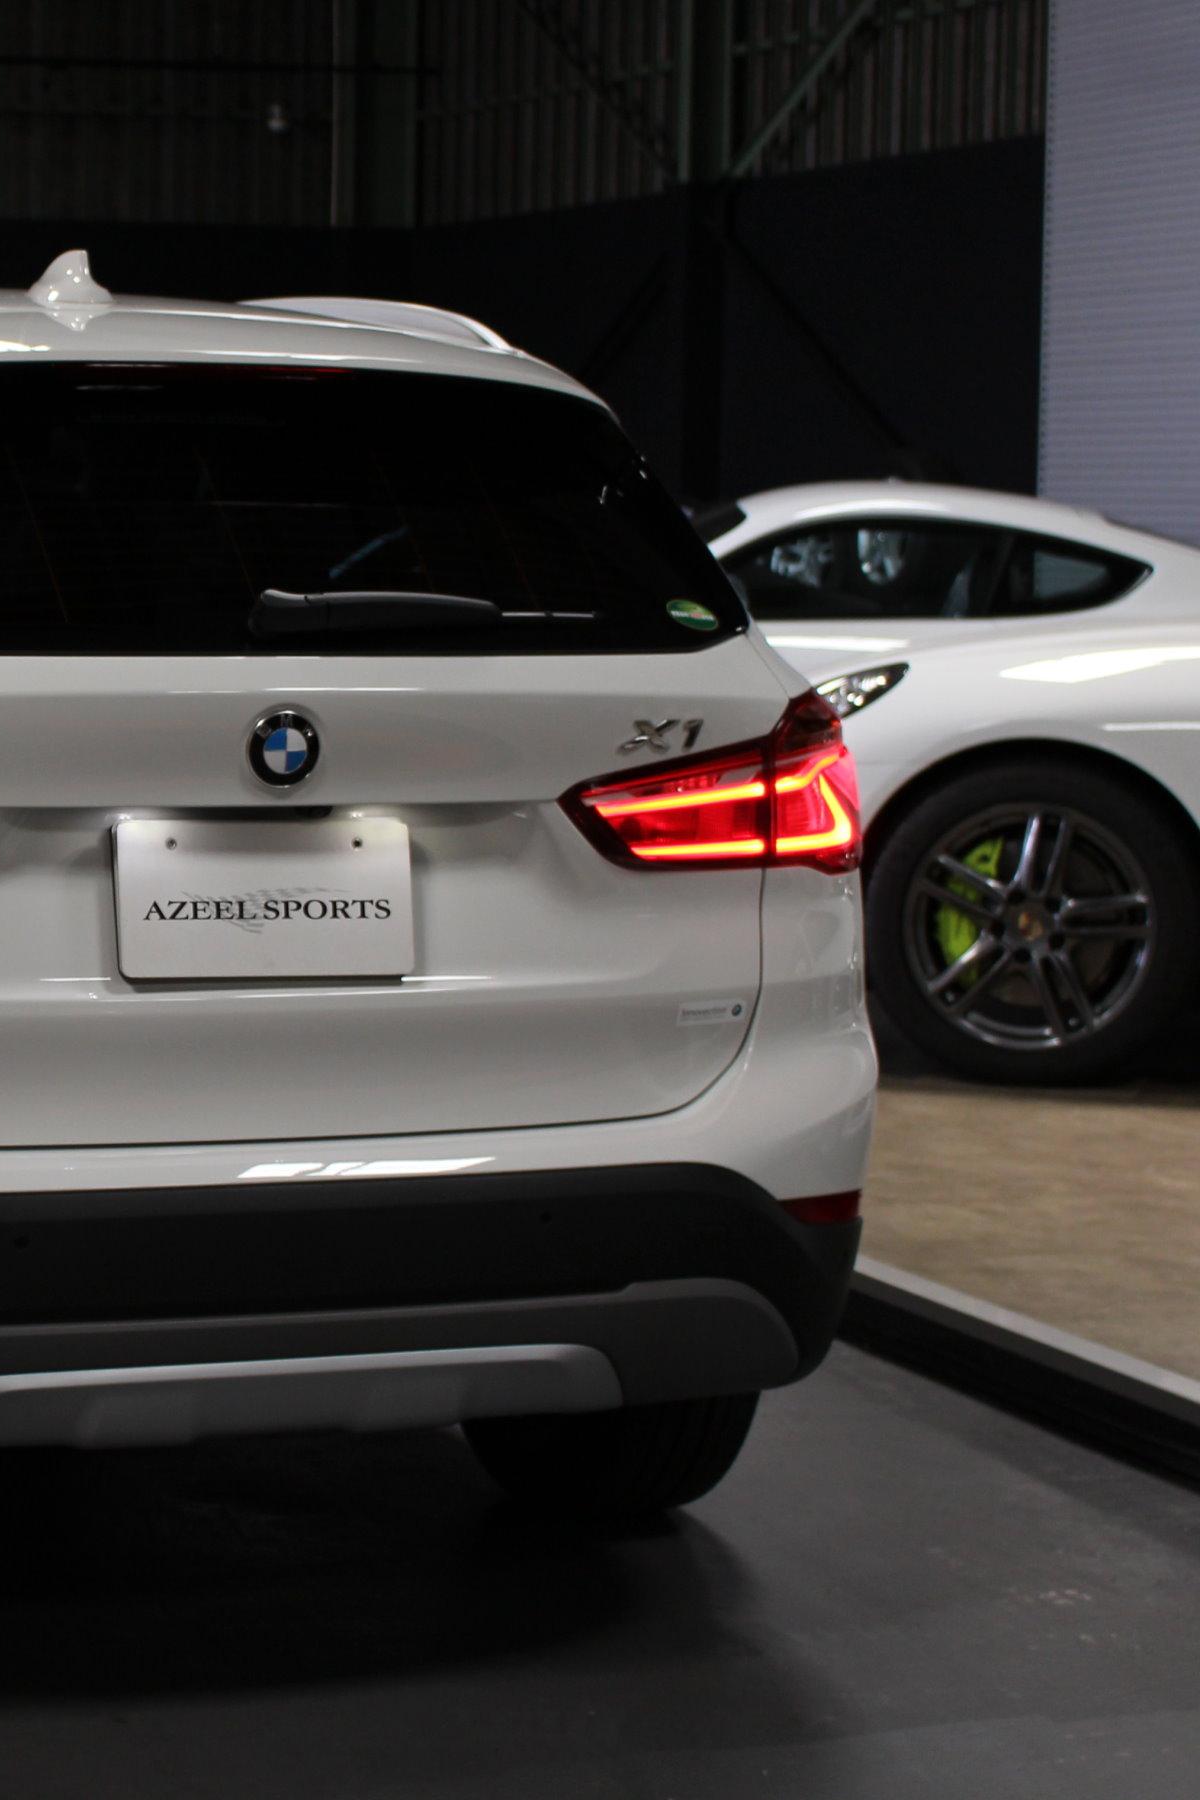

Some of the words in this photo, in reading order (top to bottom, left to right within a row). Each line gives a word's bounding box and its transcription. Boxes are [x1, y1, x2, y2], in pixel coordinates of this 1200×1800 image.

[617, 719, 704, 755] X1
[144, 900, 257, 920] AZEEL
[263, 899, 392, 920] SPORTS
